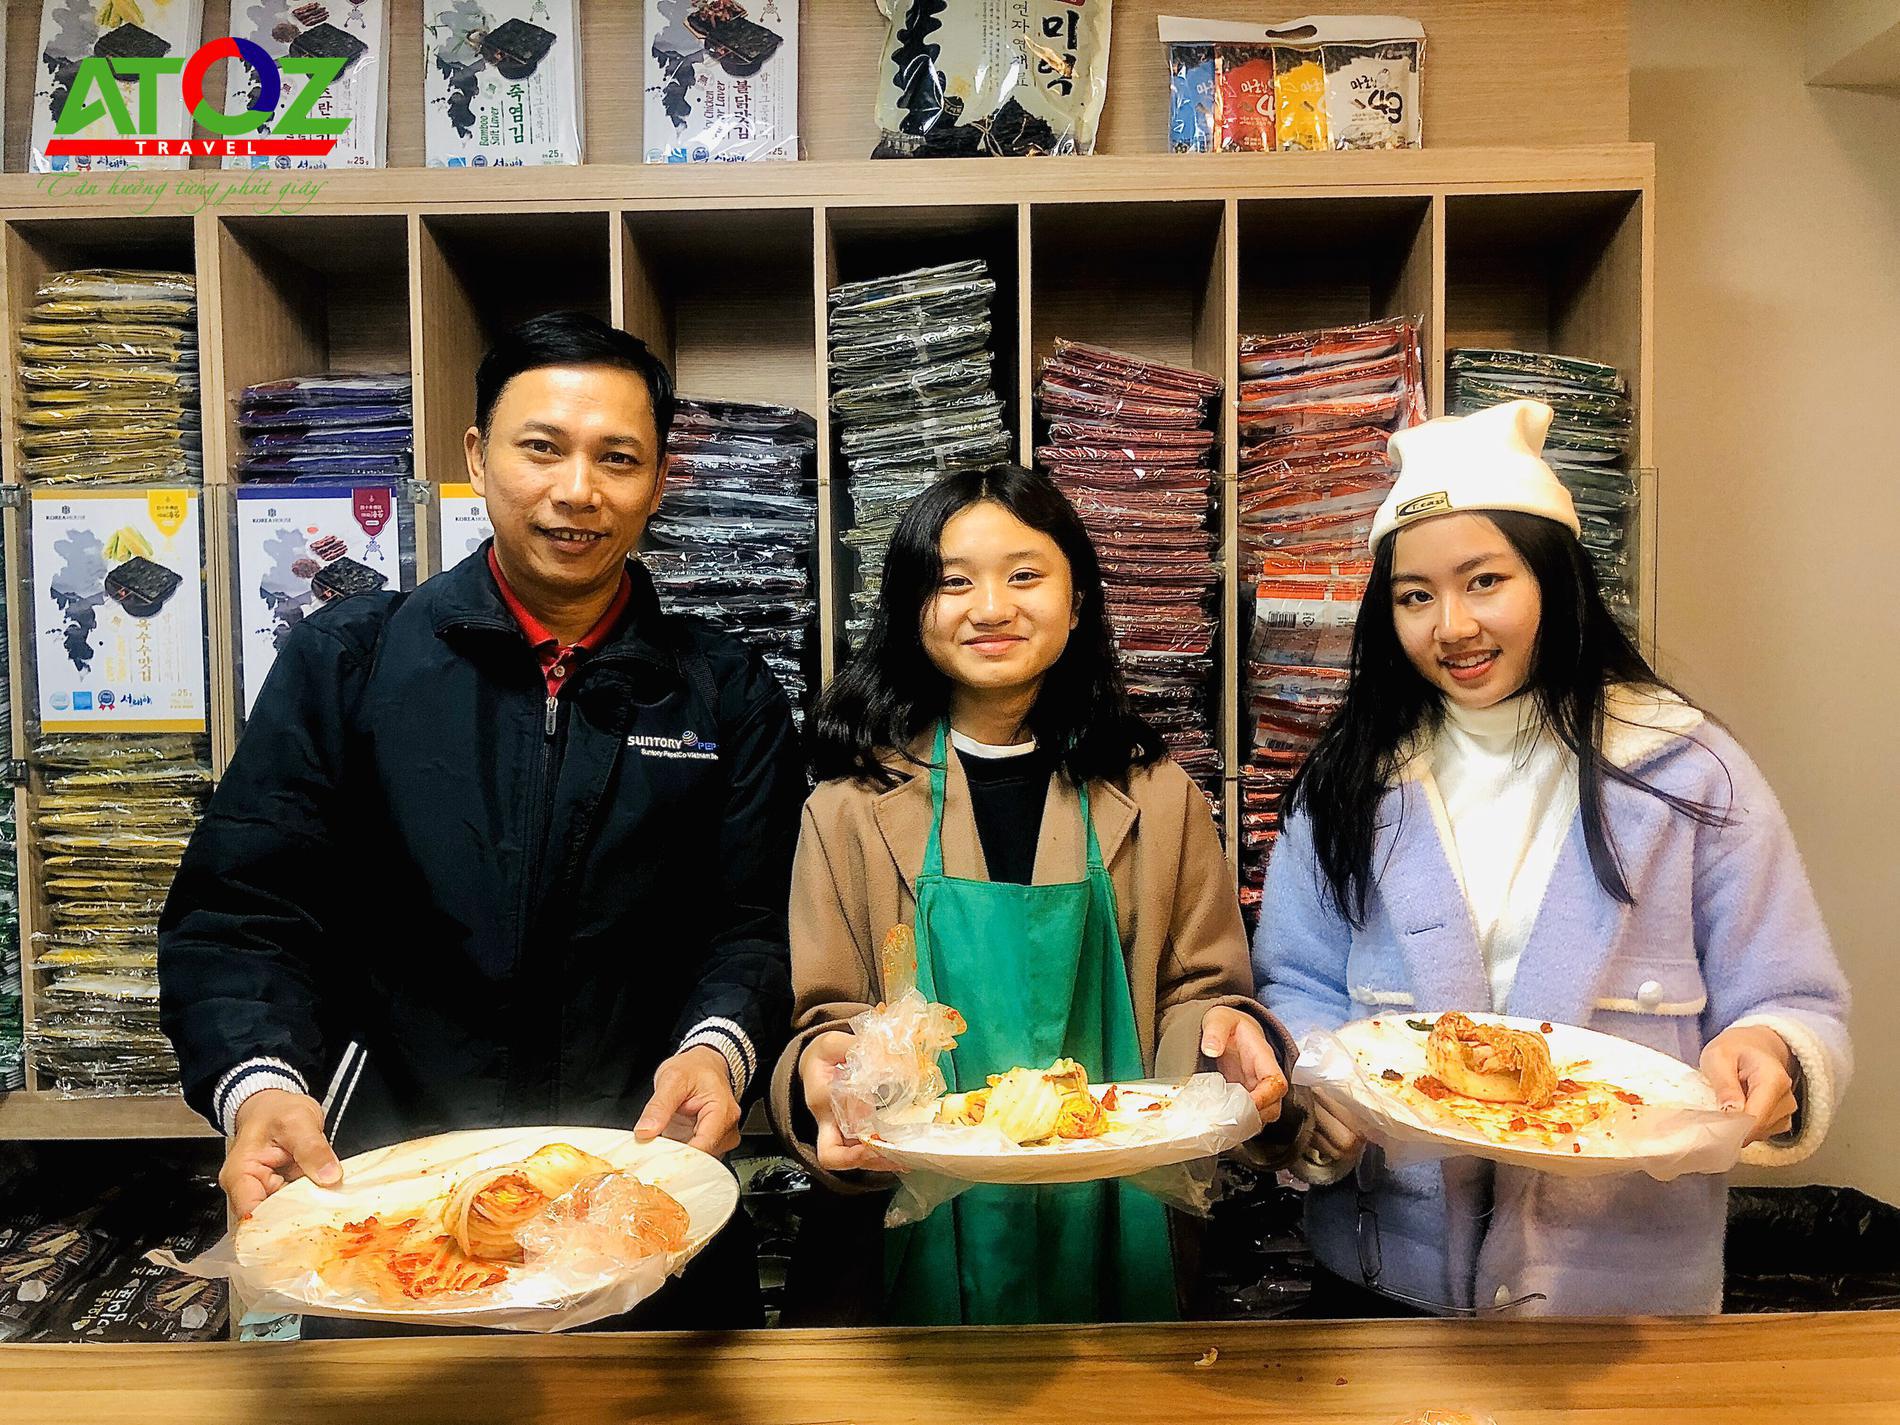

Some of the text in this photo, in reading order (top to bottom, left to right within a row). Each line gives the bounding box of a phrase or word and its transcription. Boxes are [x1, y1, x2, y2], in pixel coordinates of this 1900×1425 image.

[703, 91, 714, 119] Chicken
[715, 81, 726, 107] Laver
[506, 84, 525, 143] 죽염김
[733, 80, 752, 139] 불닭맛김
[479, 115, 489, 146] Bamboo
[490, 107, 500, 145] Salt Laver
[627, 735, 682, 750] SUNTORY
[641, 748, 662, 758] Suntory
[663, 750, 686, 760] PepsiCo
[687, 752, 710, 760] Vietnam
